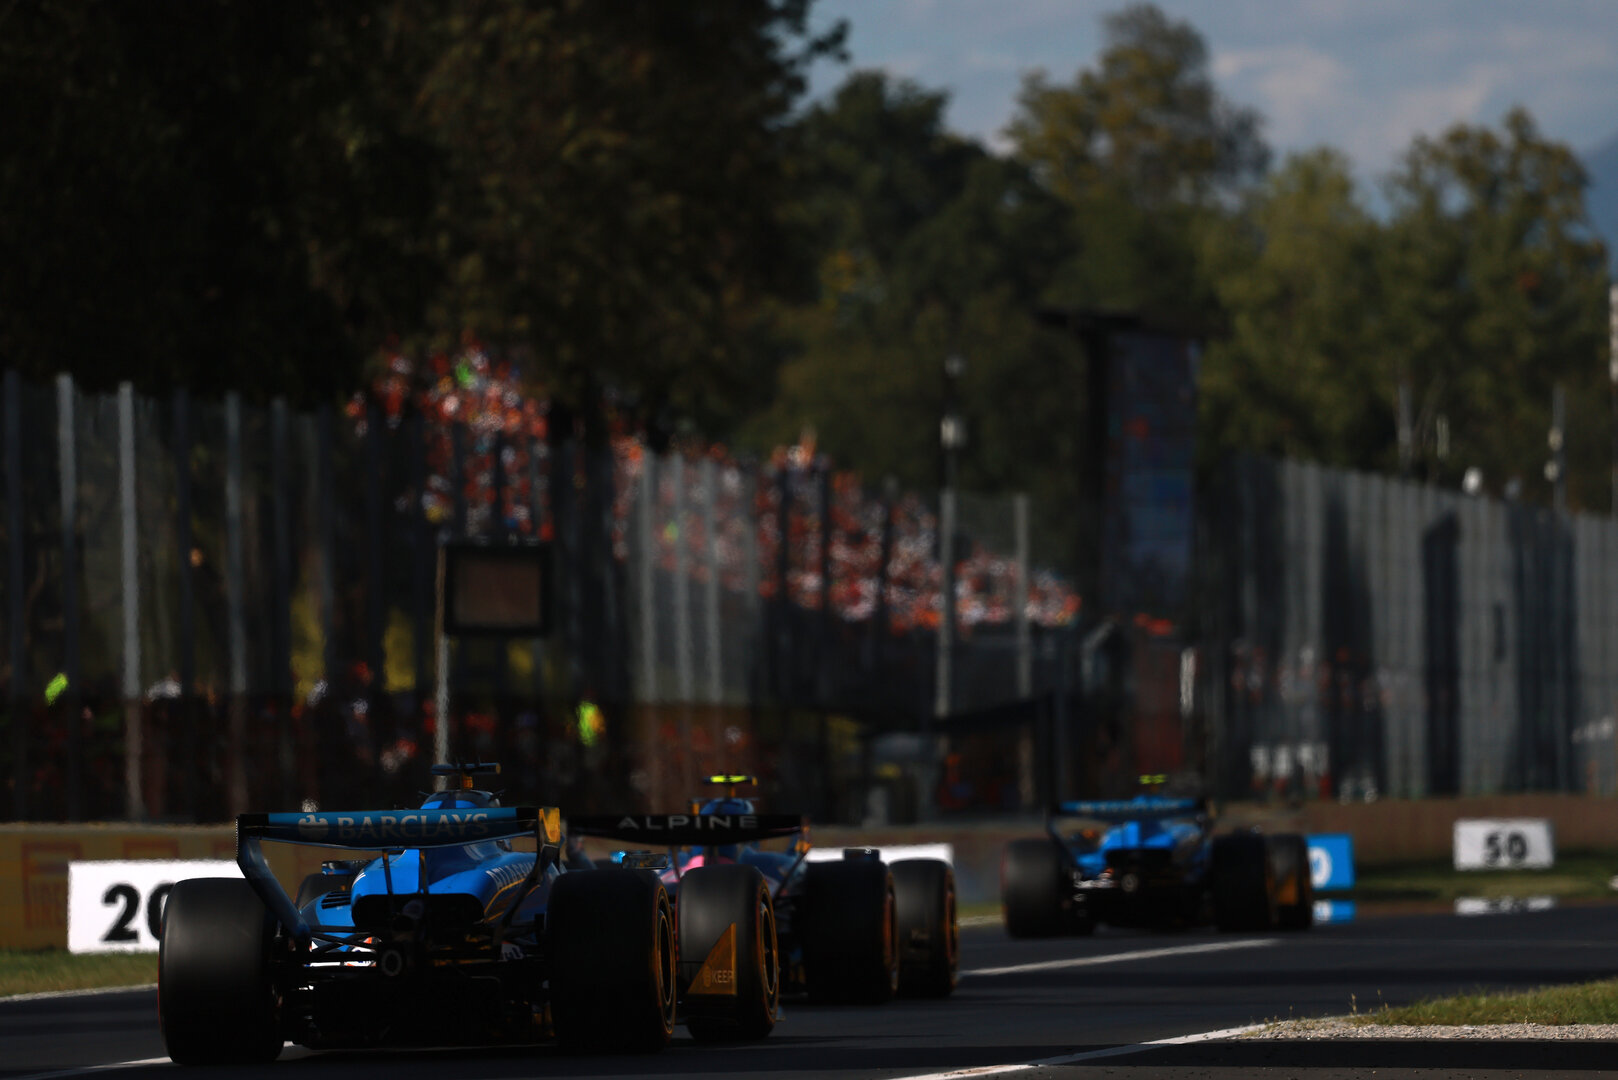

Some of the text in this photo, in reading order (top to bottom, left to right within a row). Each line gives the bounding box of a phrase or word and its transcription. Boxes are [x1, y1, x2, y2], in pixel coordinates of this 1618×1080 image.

[337, 813, 489, 839] BARCLAYS
[616, 814, 760, 830] ALPINE
[1486, 833, 1527, 864] 50
